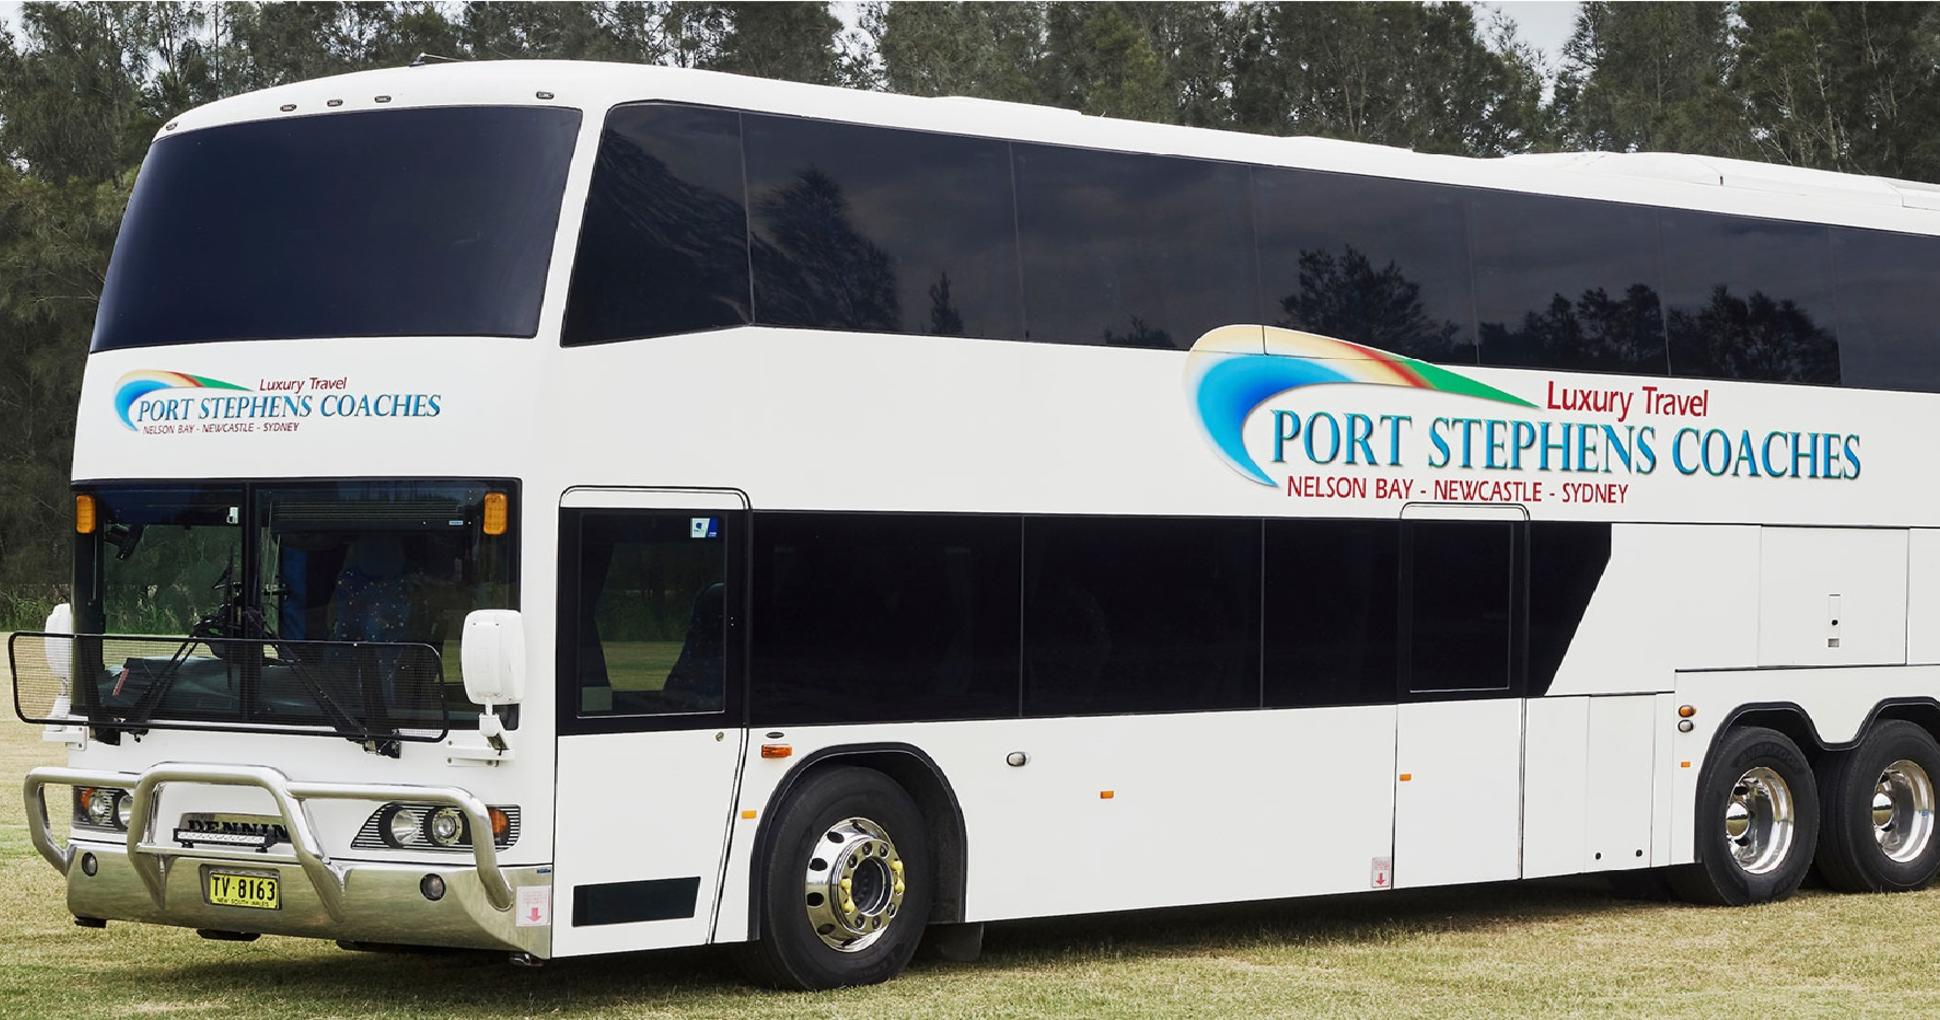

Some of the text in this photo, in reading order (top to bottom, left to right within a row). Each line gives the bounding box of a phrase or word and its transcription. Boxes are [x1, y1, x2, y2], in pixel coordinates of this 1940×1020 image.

[259, 377, 347, 394] Luxury Travel
[137, 394, 442, 422] PORT STEPHENS COACHES
[1547, 380, 1709, 422] Luxury Travel
[143, 425, 175, 435] NELSON
[178, 424, 195, 434] BAY
[202, 422, 254, 433] NEWCASTLE
[263, 422, 300, 432] SYDNEY
[1270, 408, 1862, 481] PORT STEPHENS COACHES
[1287, 475, 1367, 499] NELSON
[1376, 478, 1414, 500] BAY
[1434, 480, 1542, 502] NEWCASTLE
[1562, 483, 1629, 504] SYDNEY
[187, 820, 290, 839] DENNIN
